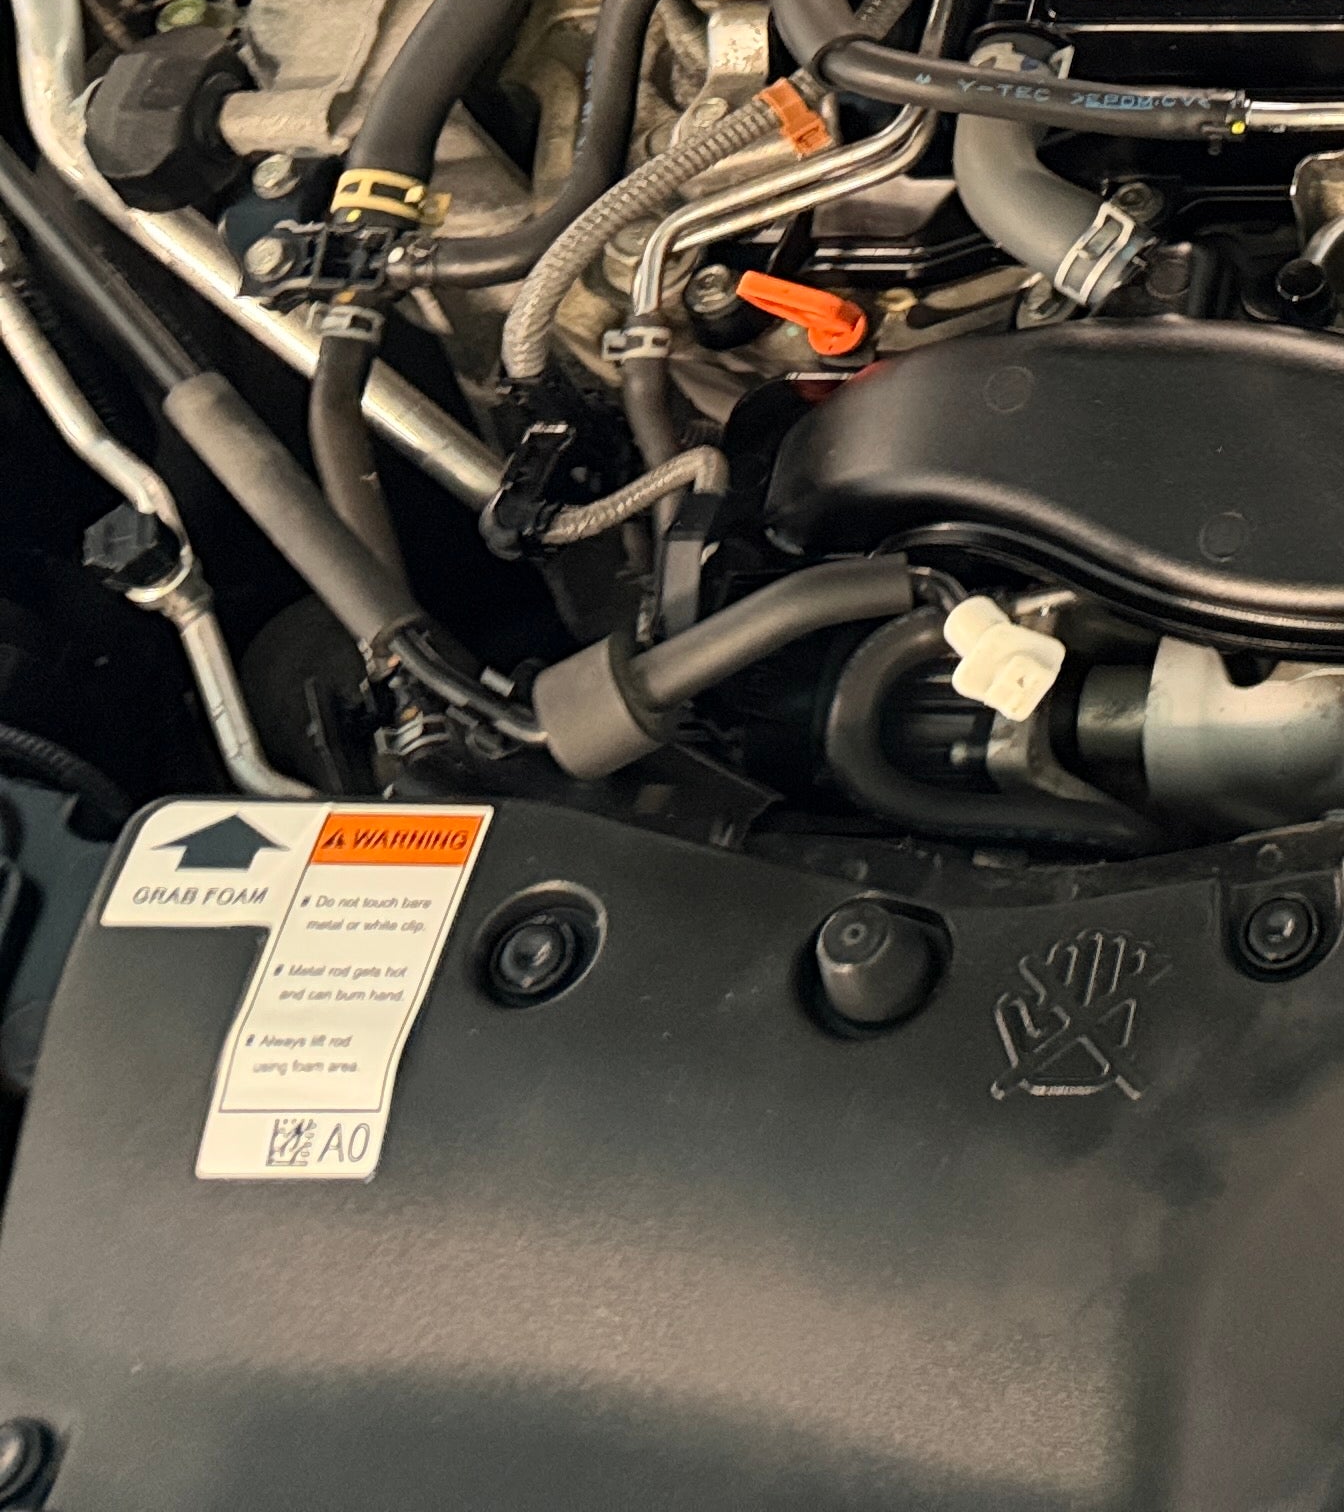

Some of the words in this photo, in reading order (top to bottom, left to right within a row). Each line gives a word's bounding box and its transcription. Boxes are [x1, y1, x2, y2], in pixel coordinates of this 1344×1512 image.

[957, 78, 1052, 103] Y-TEC
[352, 829, 469, 851] WARNING
[132, 886, 197, 906] GRAB
[201, 886, 269, 906] FOAM
[316, 895, 334, 909] Do
[338, 896, 359, 909] not
[362, 895, 399, 909] touch
[401, 896, 433, 910] bare
[307, 919, 345, 932] metal
[346, 920, 362, 932] or
[364, 919, 399, 932] white
[288, 964, 326, 977] Metal
[328, 964, 352, 977] rod
[353, 966, 382, 980] gets
[385, 965, 408, 978] hot
[279, 988, 305, 1001] and
[307, 990, 332, 1001] can
[335, 988, 366, 1002] burn
[258, 1035, 307, 1049] Always
[310, 1034, 327, 1048] lift
[329, 1035, 353, 1048] rod
[252, 1062, 289, 1076] using
[291, 1060, 325, 1073] foam
